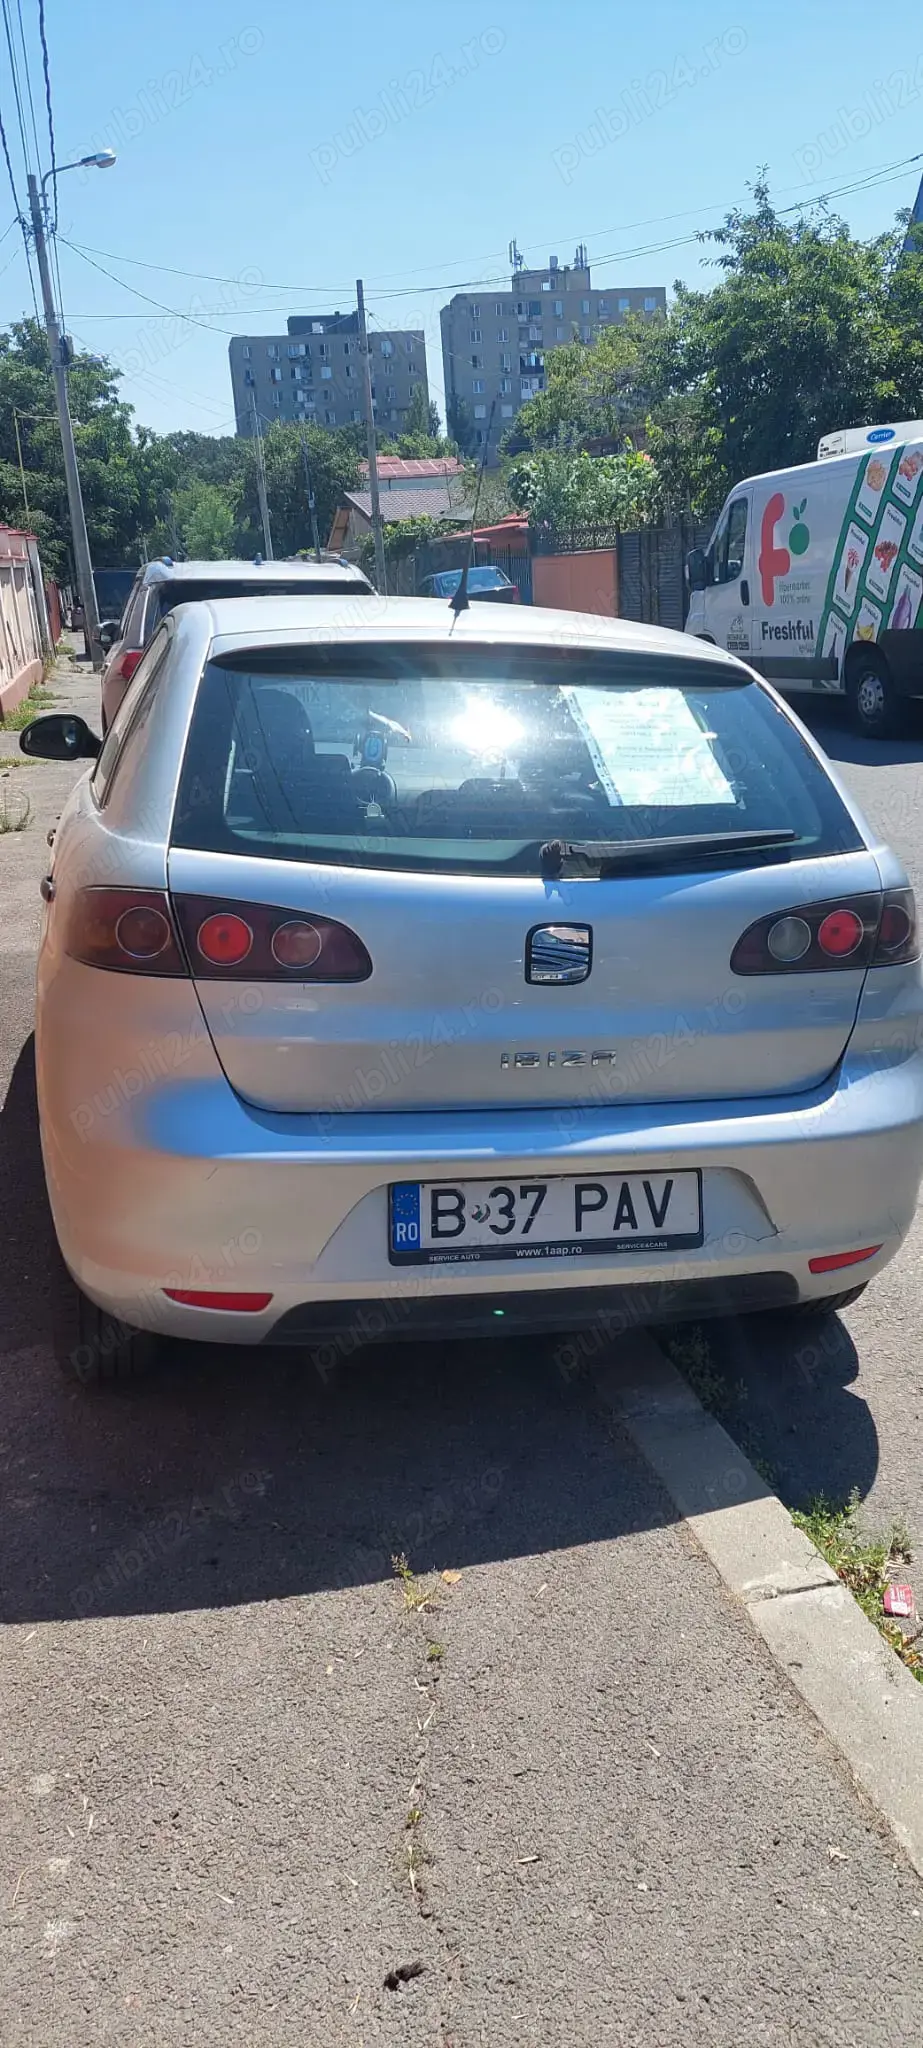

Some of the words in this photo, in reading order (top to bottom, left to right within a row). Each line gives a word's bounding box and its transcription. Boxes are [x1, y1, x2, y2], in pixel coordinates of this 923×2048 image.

[761, 619, 814, 641] Freshful
[500, 1050, 617, 1069] IBIZA
[431, 1188, 466, 1239] B
[489, 1185, 548, 1235] 37
[574, 1179, 674, 1233] PAV
[396, 1222, 418, 1243] RO
[429, 1253, 460, 1262] SERVICE
[461, 1253, 480, 1261] AUTO
[516, 1244, 583, 1258] www.1aap.ro
